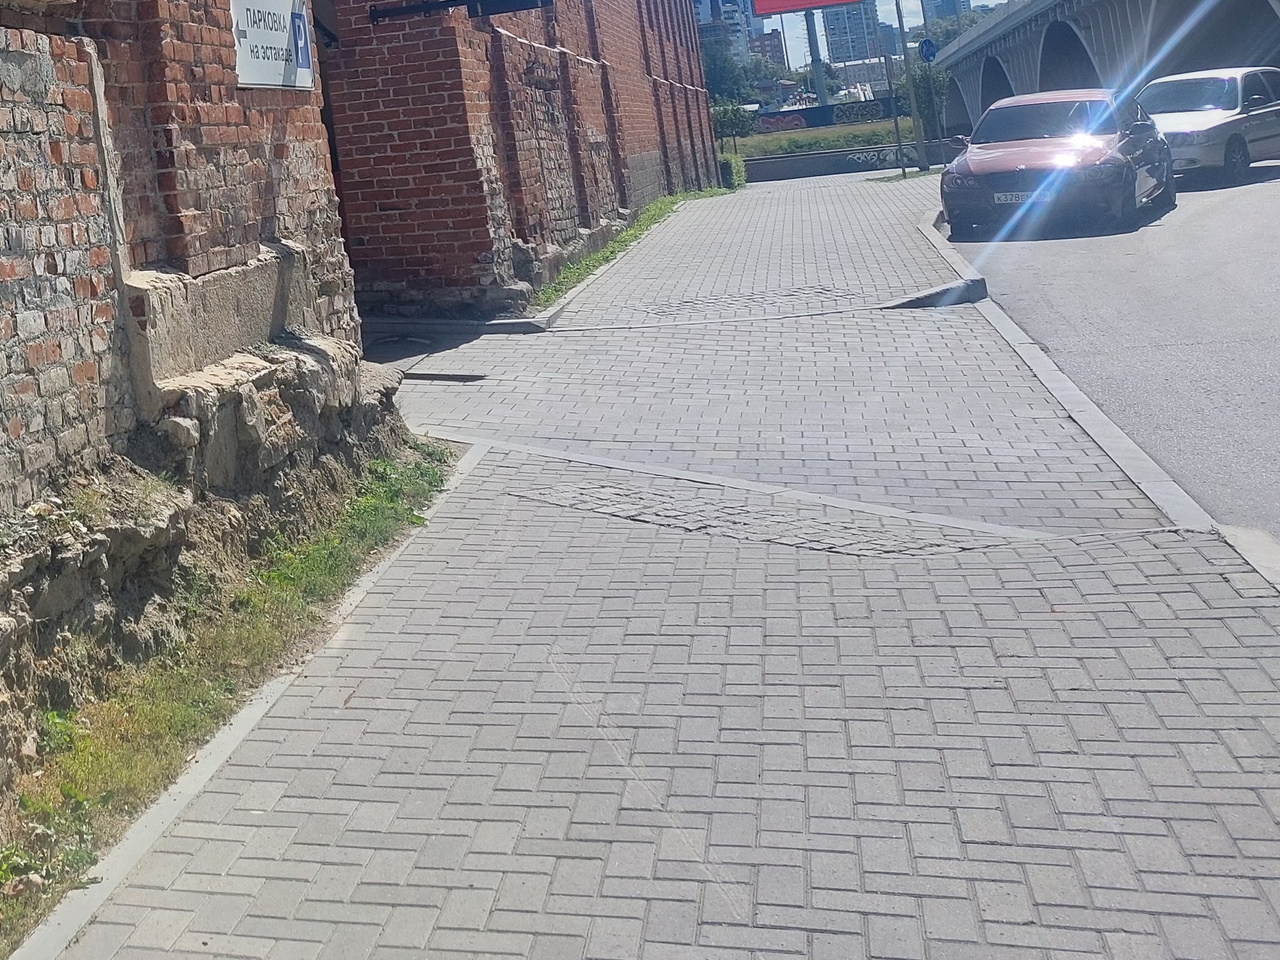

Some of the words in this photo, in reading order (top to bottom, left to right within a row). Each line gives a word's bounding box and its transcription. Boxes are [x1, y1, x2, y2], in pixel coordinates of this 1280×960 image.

[246, 7, 288, 33] ПАРКОВКА
[250, 43, 260, 59] на
[261, 45, 293, 66] эстакаде
